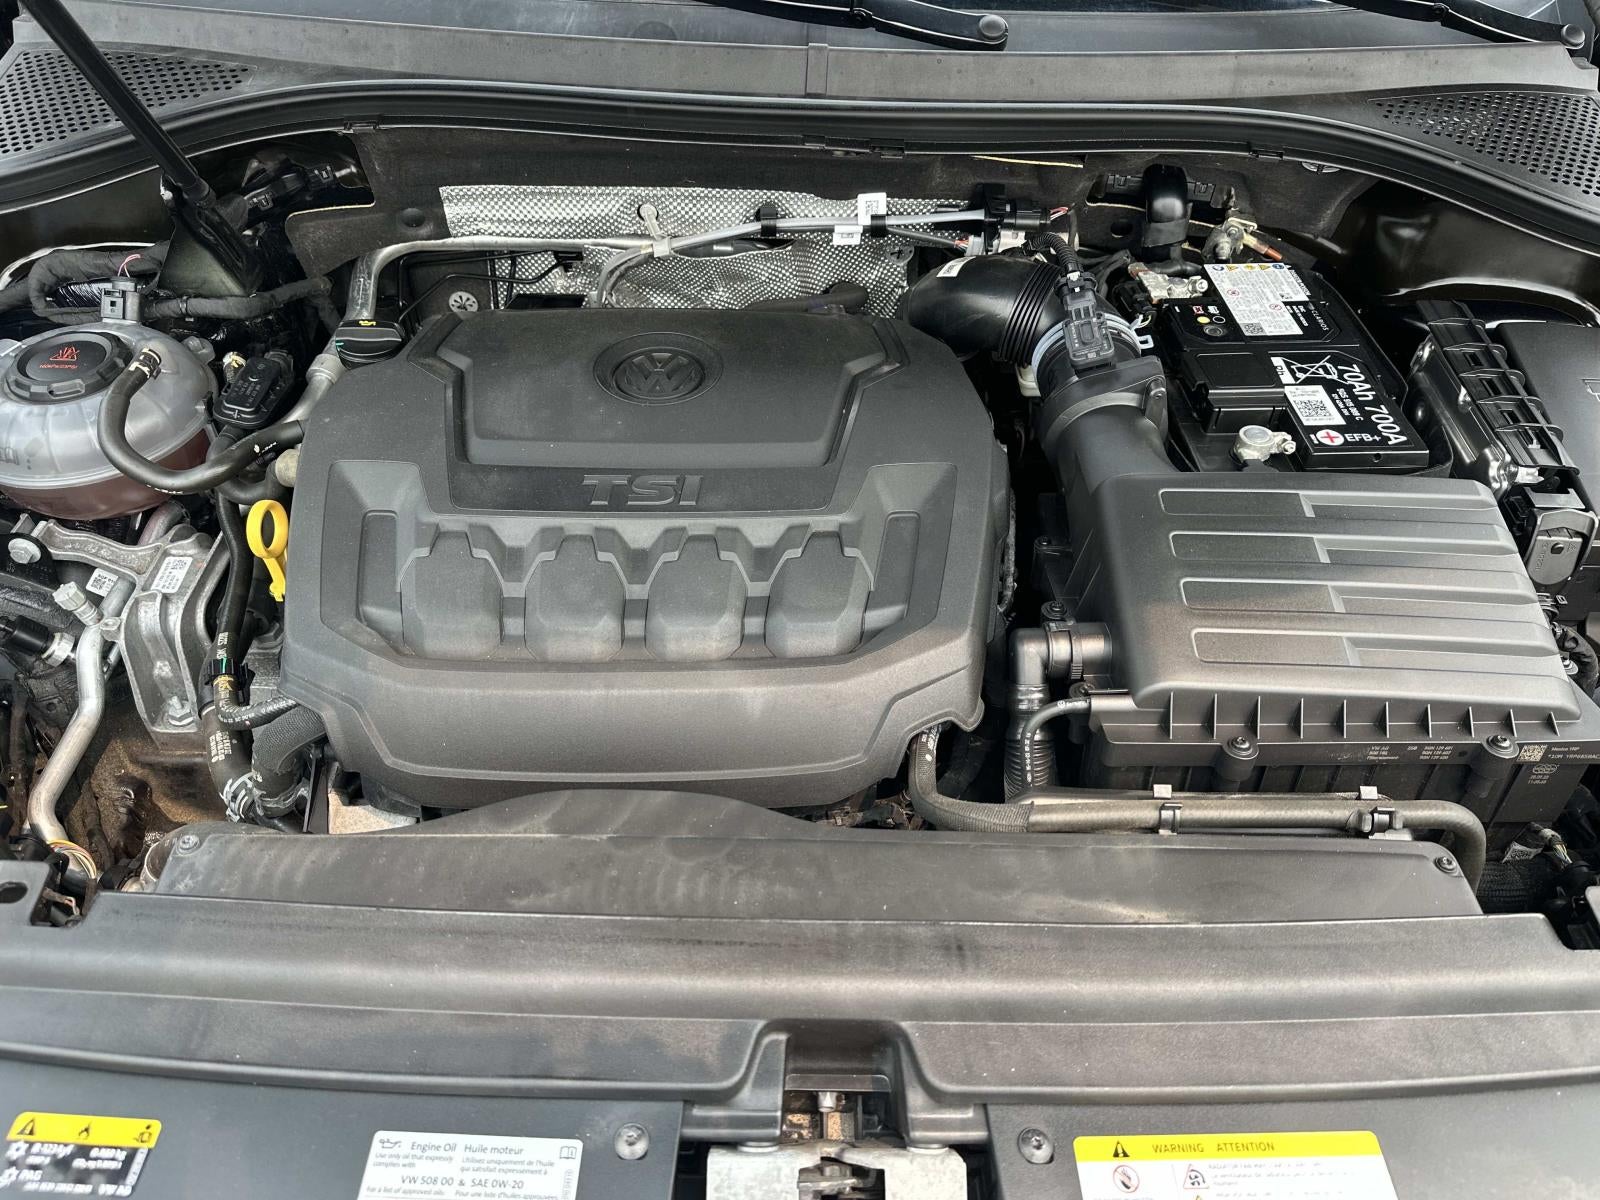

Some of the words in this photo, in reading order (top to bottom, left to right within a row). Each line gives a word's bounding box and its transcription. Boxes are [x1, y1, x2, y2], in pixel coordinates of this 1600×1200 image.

[1311, 310, 1330, 331] CLARIOS
[1338, 364, 1376, 400] 70Ah
[1364, 404, 1408, 444] 700A
[1345, 433, 1381, 442] EFB+
[582, 474, 704, 506] TSI
[411, 1142, 442, 1153] Engine
[444, 1143, 457, 1152] Oil
[464, 1144, 488, 1153] Huile
[490, 1146, 524, 1155] moteur
[1152, 1143, 1204, 1153] WARNING
[1216, 1142, 1275, 1152] ATTENTION
[401, 1176, 418, 1184] VW
[420, 1176, 438, 1185] 508
[441, 1177, 454, 1186] 00
[471, 1178, 489, 1187] SAE
[492, 1179, 524, 1189] 0W-20
